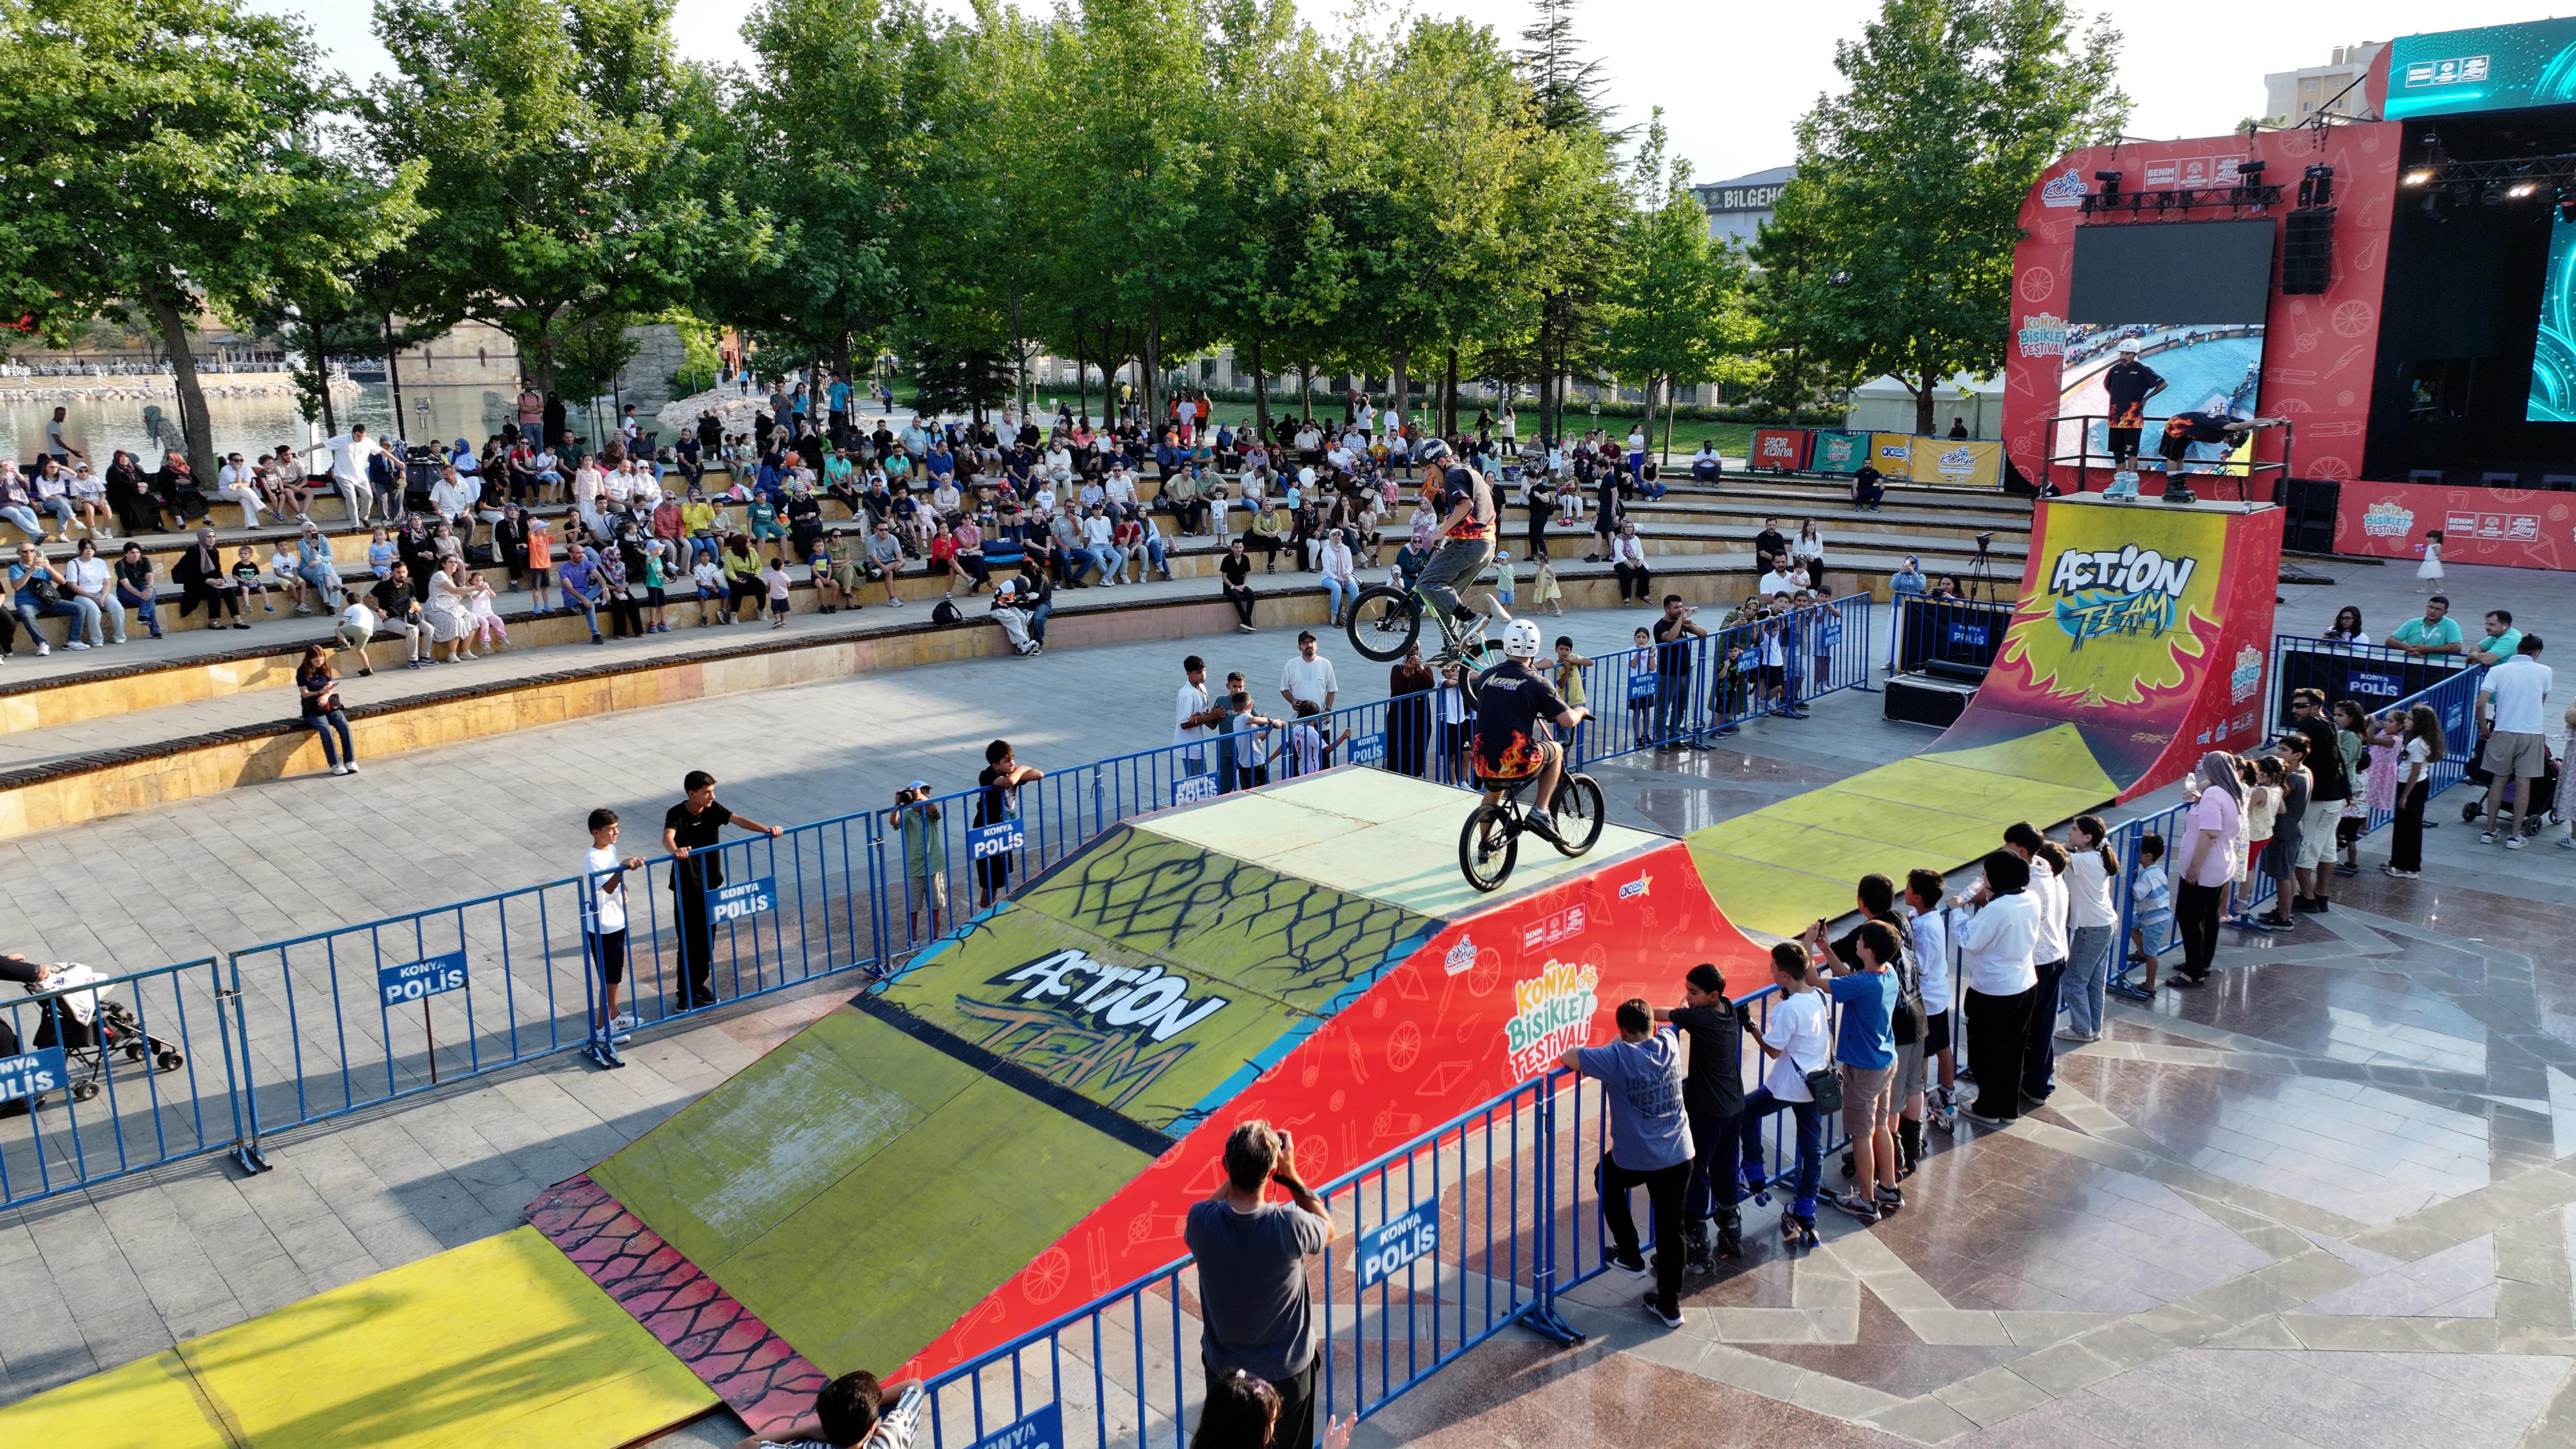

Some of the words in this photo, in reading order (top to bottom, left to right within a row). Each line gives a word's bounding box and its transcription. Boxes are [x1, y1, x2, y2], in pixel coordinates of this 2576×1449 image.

[2024, 313, 2059, 330] KONYA
[2020, 342, 2064, 357] FESTİVAL
[1425, 443, 1444, 459] Odyssey
[1763, 444, 1793, 457] KONYA
[1764, 437, 1789, 447] SPOR
[1882, 446, 1906, 457] aces
[2370, 503, 2401, 517] KONYA
[2052, 544, 2196, 597] ACTION
[2061, 590, 2169, 652] TEAM
[1825, 632, 1840, 646] POLİS
[1738, 656, 1759, 672] POLİS
[2360, 674, 2389, 682] KONYA
[1632, 682, 1655, 698] POLİS
[2350, 681, 2398, 696] POLİS
[1358, 735, 1379, 746] KONYA
[1354, 744, 1383, 763] POLİS
[984, 824, 1013, 837] KONYA
[974, 832, 1024, 858] POLİS
[720, 882, 759, 900] KONYA
[1620, 880, 1643, 897] aces
[714, 893, 768, 922] POLİS
[400, 960, 446, 978] KONYA
[385, 969, 463, 1004] POLİS
[1003, 948, 1228, 1043] ACTION
[1517, 962, 1577, 1017] KONYA
[1508, 991, 1591, 1052] BİSİKLET
[955, 994, 1199, 1111] TEAM
[1512, 1015, 1590, 1080] FESTİVALİ
[0, 1057, 39, 1073] NYA
[0, 1070, 54, 1101] LİS
[1626, 1074, 1648, 1092] LOS
[1628, 1087, 1661, 1106] WEST
[1380, 1213, 1422, 1246] KONYA
[1366, 1224, 1435, 1286] POLİS
[984, 1422, 1037, 1449] NYA
